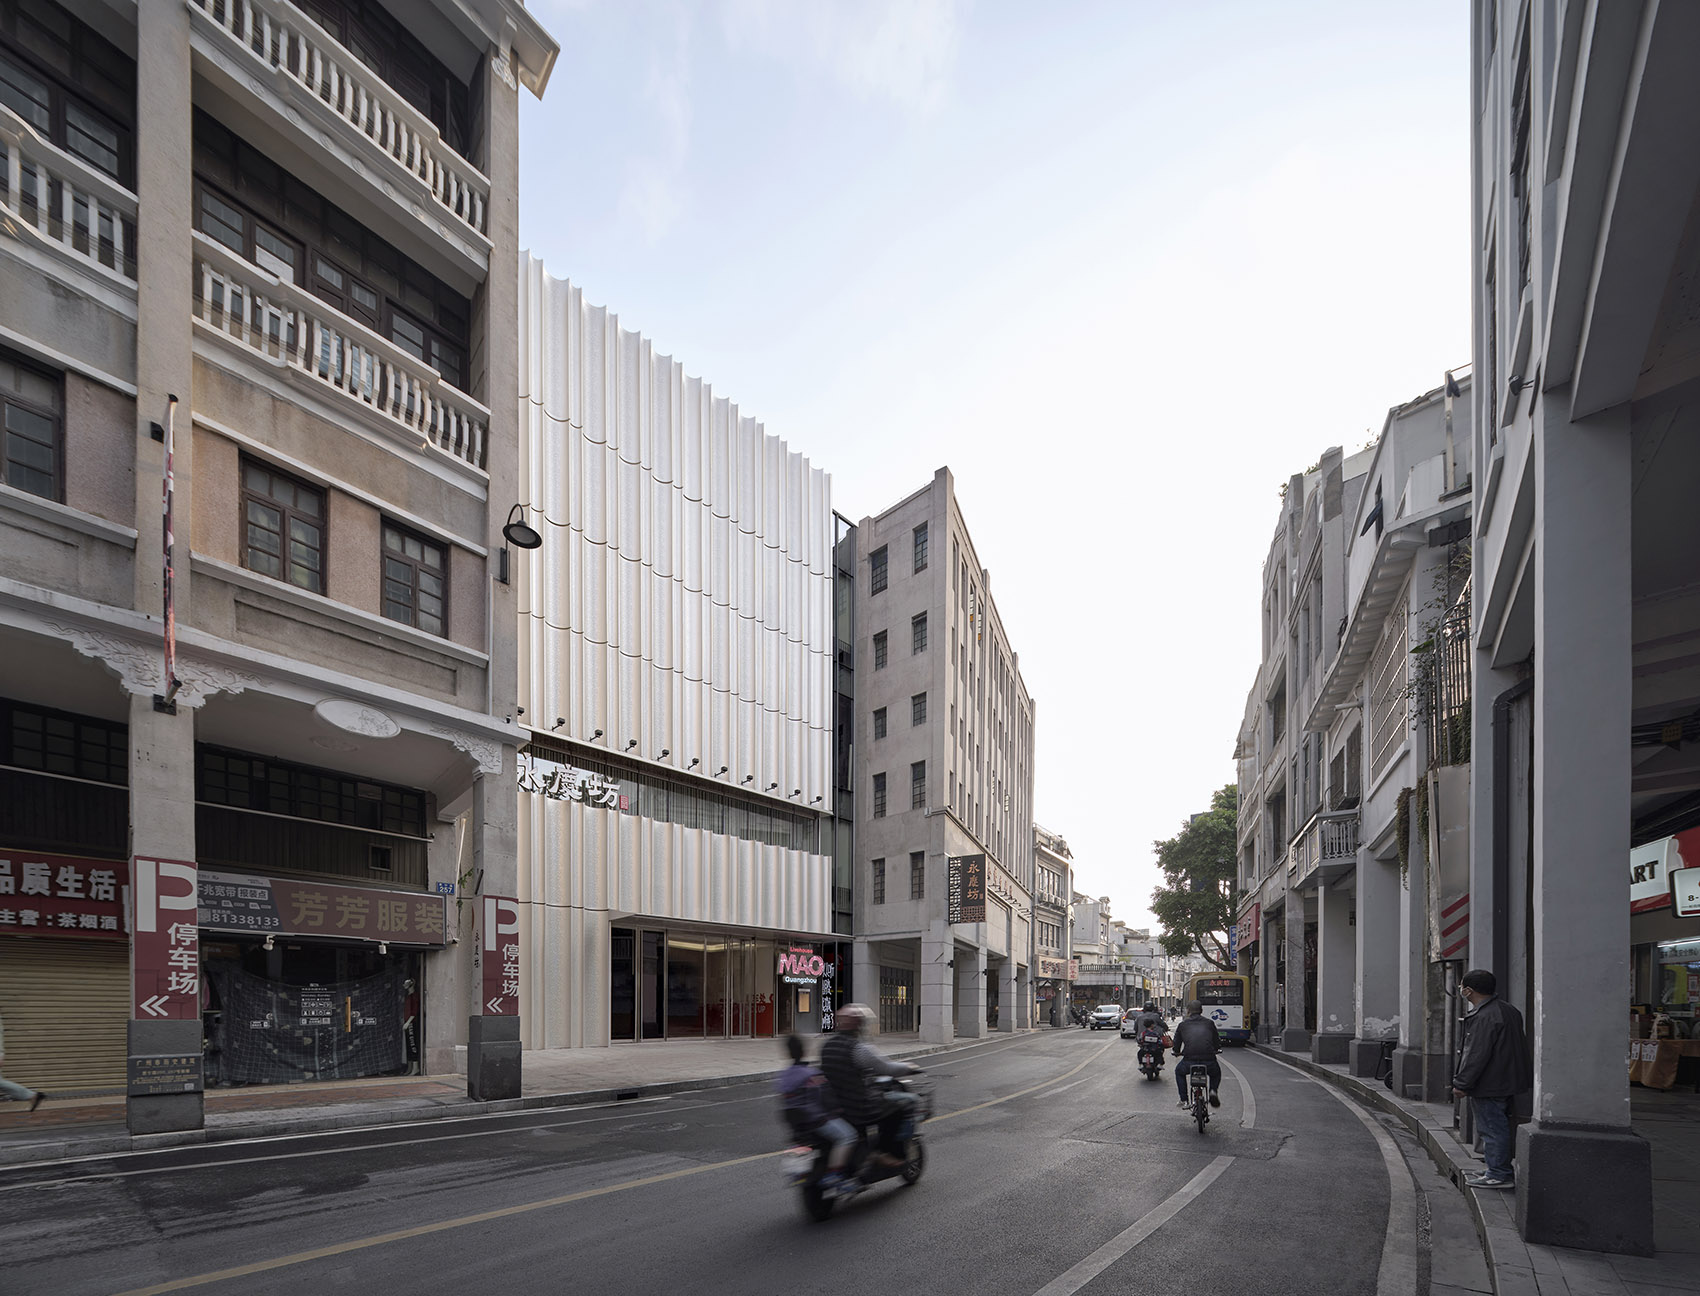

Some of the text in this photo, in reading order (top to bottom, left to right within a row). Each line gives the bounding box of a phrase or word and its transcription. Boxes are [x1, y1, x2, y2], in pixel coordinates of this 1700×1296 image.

[0, 859, 117, 901] 品质生活
[1630, 859, 1658, 885] RT
[136, 859, 197, 932] P
[291, 890, 443, 934] 芳芳服装
[212, 913, 279, 927] 81338133
[484, 897, 519, 951] P
[167, 922, 198, 995] 停车场
[502, 943, 519, 997] 停车场
[779, 953, 824, 976] MAO
[784, 976, 817, 984] Guangzhou
